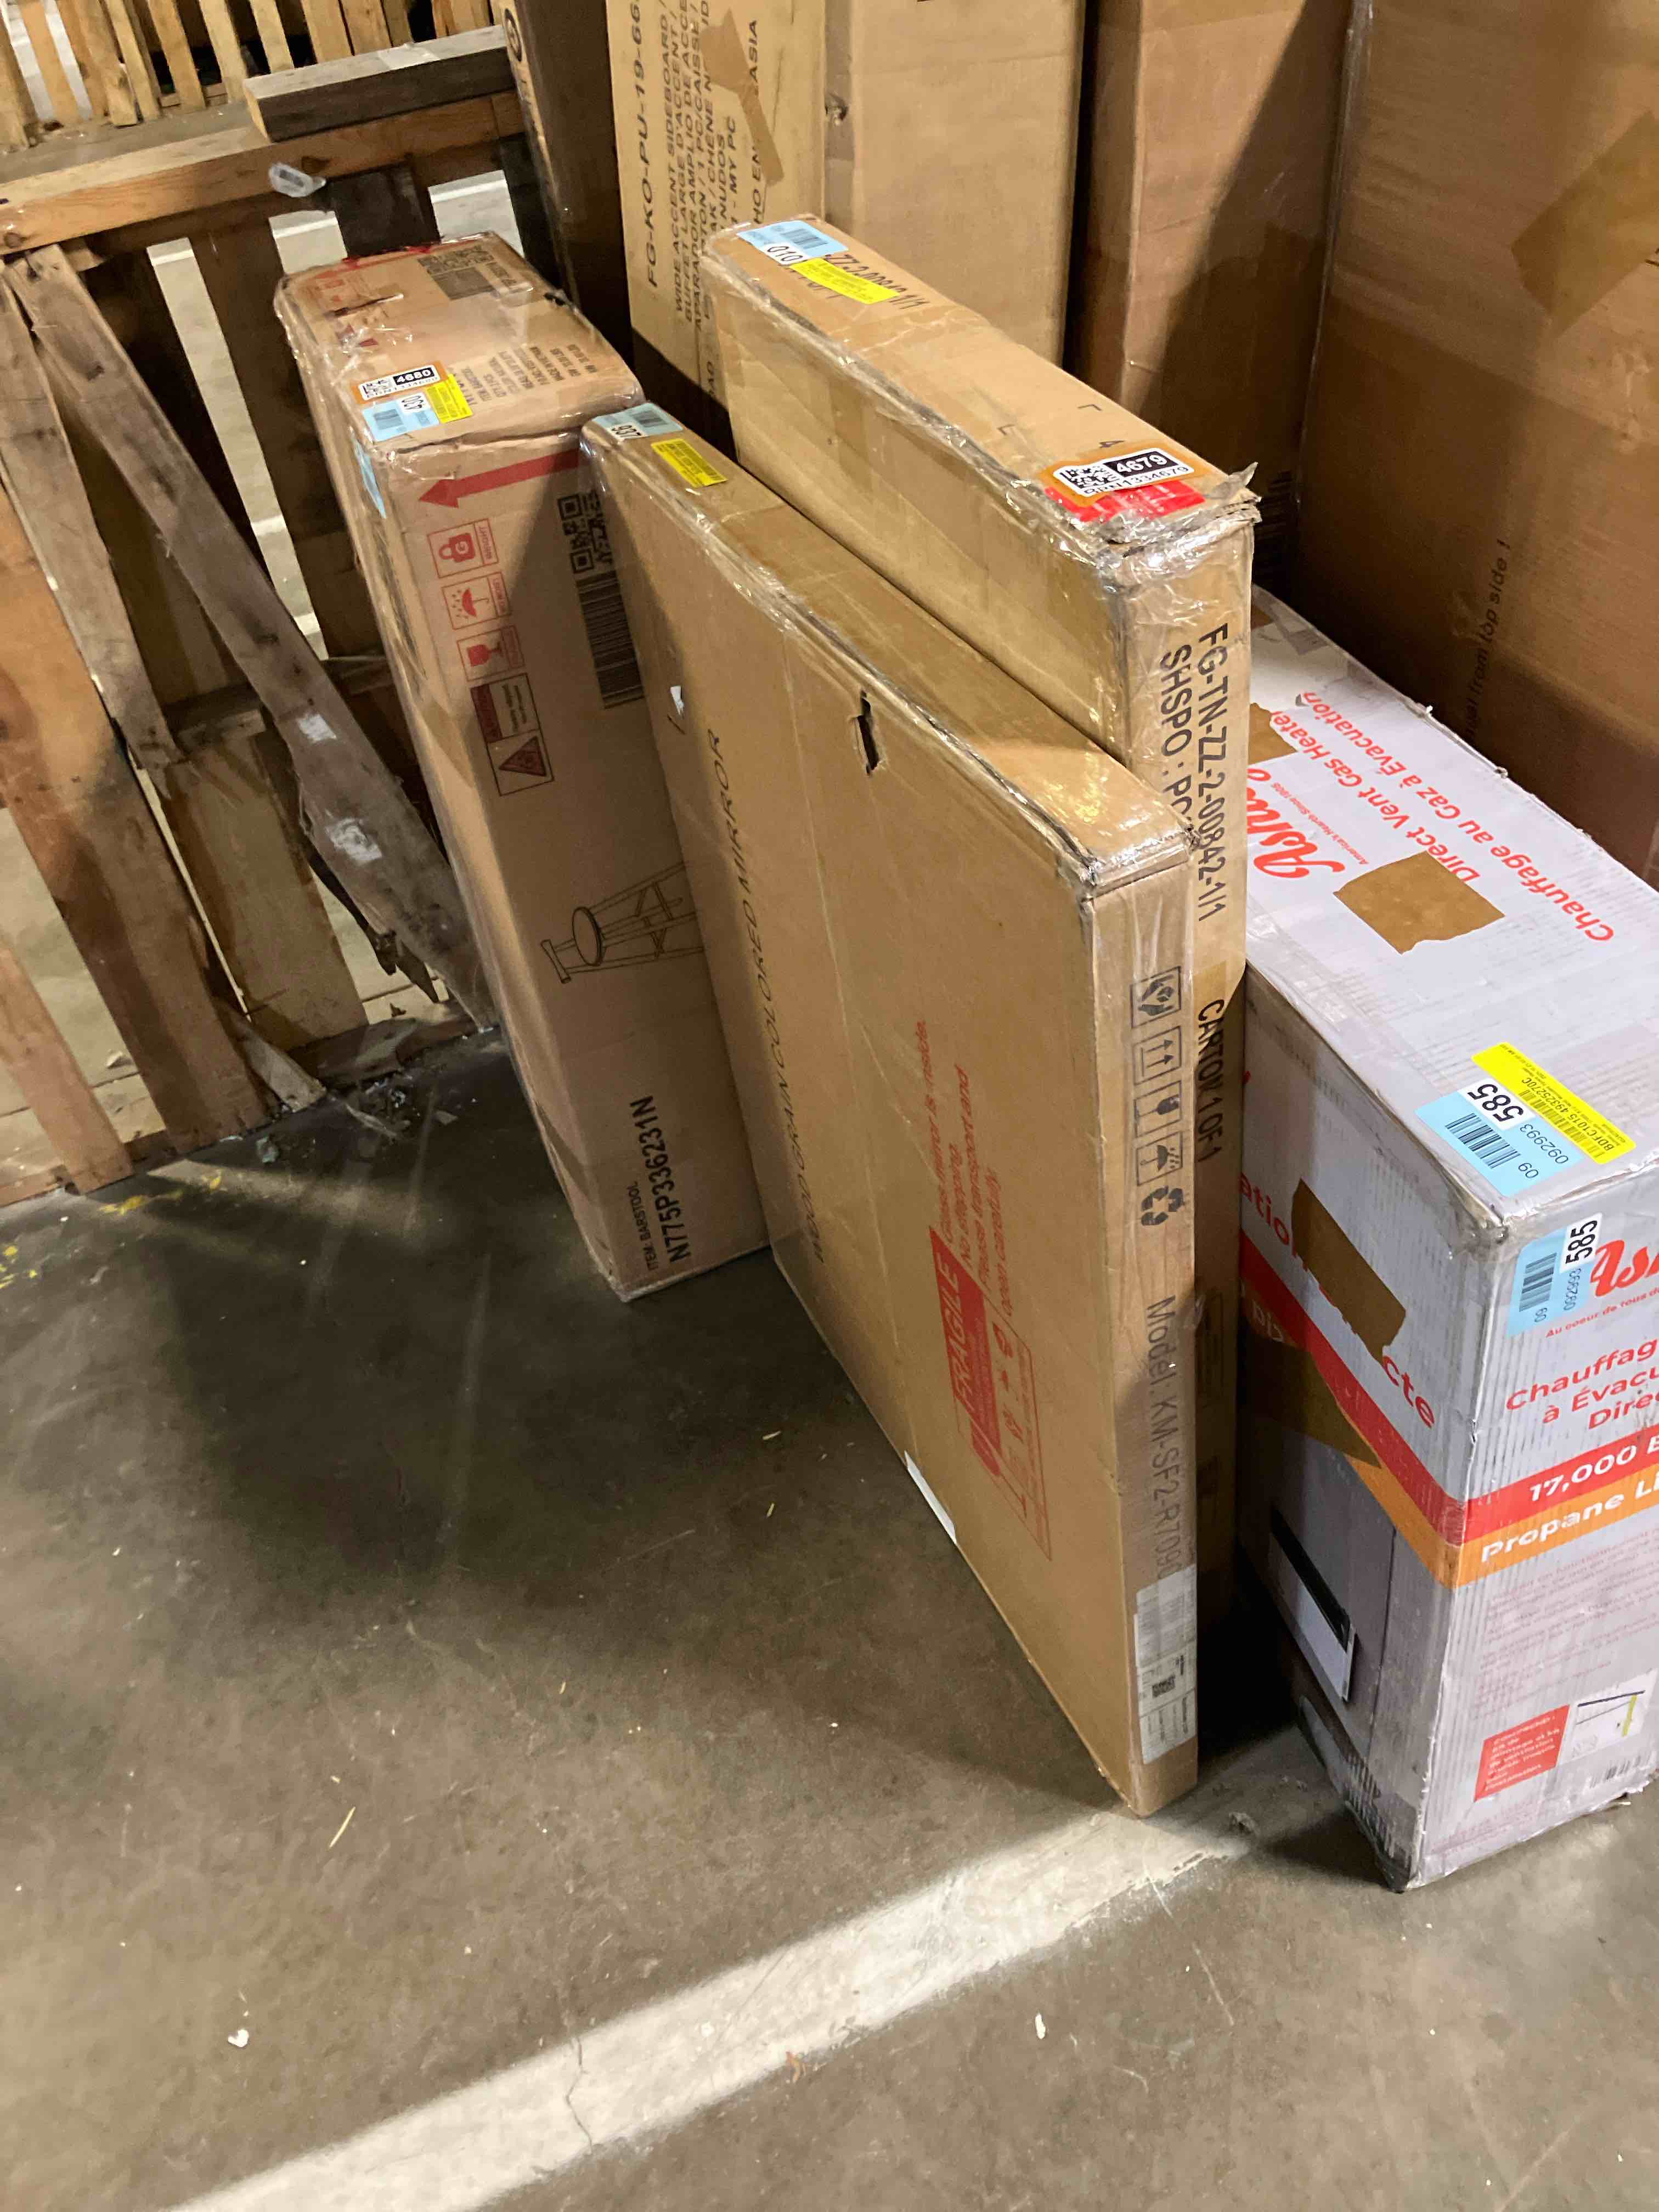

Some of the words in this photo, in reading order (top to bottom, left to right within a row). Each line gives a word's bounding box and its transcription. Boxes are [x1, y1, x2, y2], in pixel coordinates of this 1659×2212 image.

[660, 15, 675, 156] SIDEBOARD
[671, 29, 684, 150] D'ACCENT
[682, 77, 693, 107] DE
[727, 116, 736, 150] PC
[685, 115, 697, 205] AMPLIO
[715, 133, 728, 219] NUDOS
[727, 157, 738, 194] MY
[667, 163, 681, 251] ACCENT
[676, 156, 688, 236] LARGE
[709, 205, 718, 231] AK
[766, 245, 804, 263] 010
[673, 262, 684, 312] WIDE
[396, 368, 432, 383] 4680
[611, 425, 643, 438] 937
[1115, 454, 1167, 473] 4679
[1488, 556, 1508, 605] side
[1159, 644, 1193, 757] SHSPO
[1302, 691, 1407, 776] Évacuation
[1324, 758, 1362, 788] Gas
[708, 729, 751, 894] MIRROR
[1357, 787, 1409, 830] Vent
[1416, 787, 1462, 820] Gaz
[1406, 826, 1482, 883] Direct
[1458, 819, 1495, 844] au
[1489, 845, 1615, 943] Chauffage
[742, 900, 785, 1068] COLORED
[1198, 998, 1225, 1096] CARTON
[954, 1063, 972, 1117] and
[1466, 1083, 1525, 1122] 585
[1519, 1123, 1569, 1165] 092993
[629, 1095, 692, 1264] N775P336231N
[1518, 1161, 1539, 1179] 09
[1565, 1219, 1598, 1265] 585
[937, 1254, 973, 1413] FRAGILE
[1545, 1325, 1562, 1339] Au
[1602, 1302, 1618, 1317] de
[1542, 1404, 1560, 1424] à
[1530, 1444, 1637, 1502] 17,000
[1481, 1493, 1625, 1563] Propane
